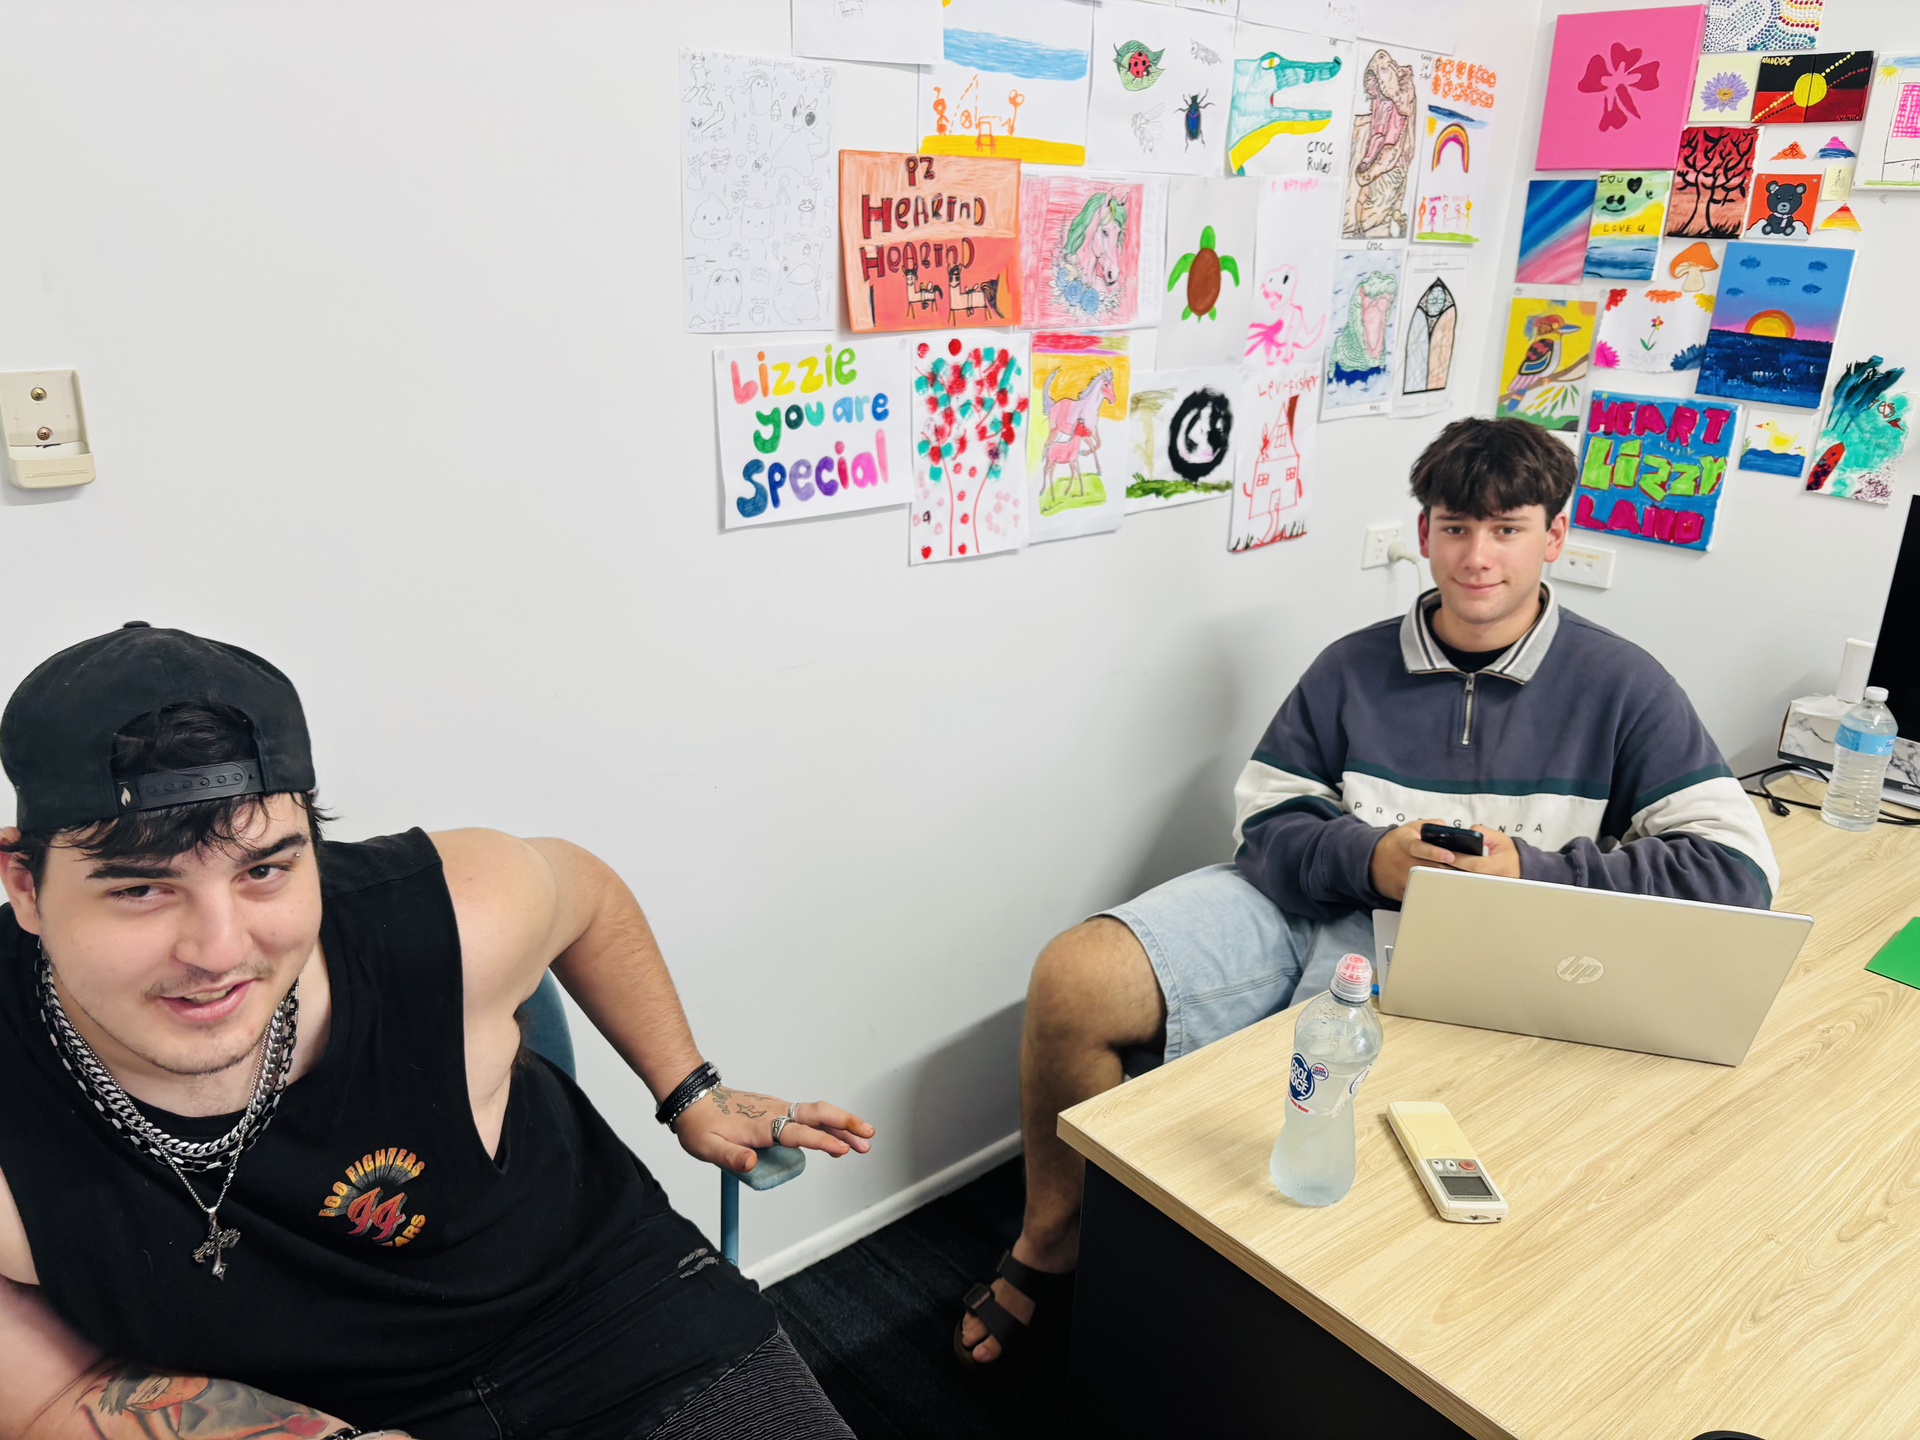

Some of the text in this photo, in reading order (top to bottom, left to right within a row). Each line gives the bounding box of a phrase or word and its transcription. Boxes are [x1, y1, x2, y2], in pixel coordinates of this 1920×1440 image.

[730, 344, 857, 405] Lizzie
[753, 392, 889, 454] you are
[1588, 399, 1731, 447] HEART
[1573, 494, 1705, 544] LAND
[1353, 801, 1543, 834] PROGNDA
[345, 1147, 425, 1183] FIGHTERS
[318, 1181, 349, 1217] FOO
